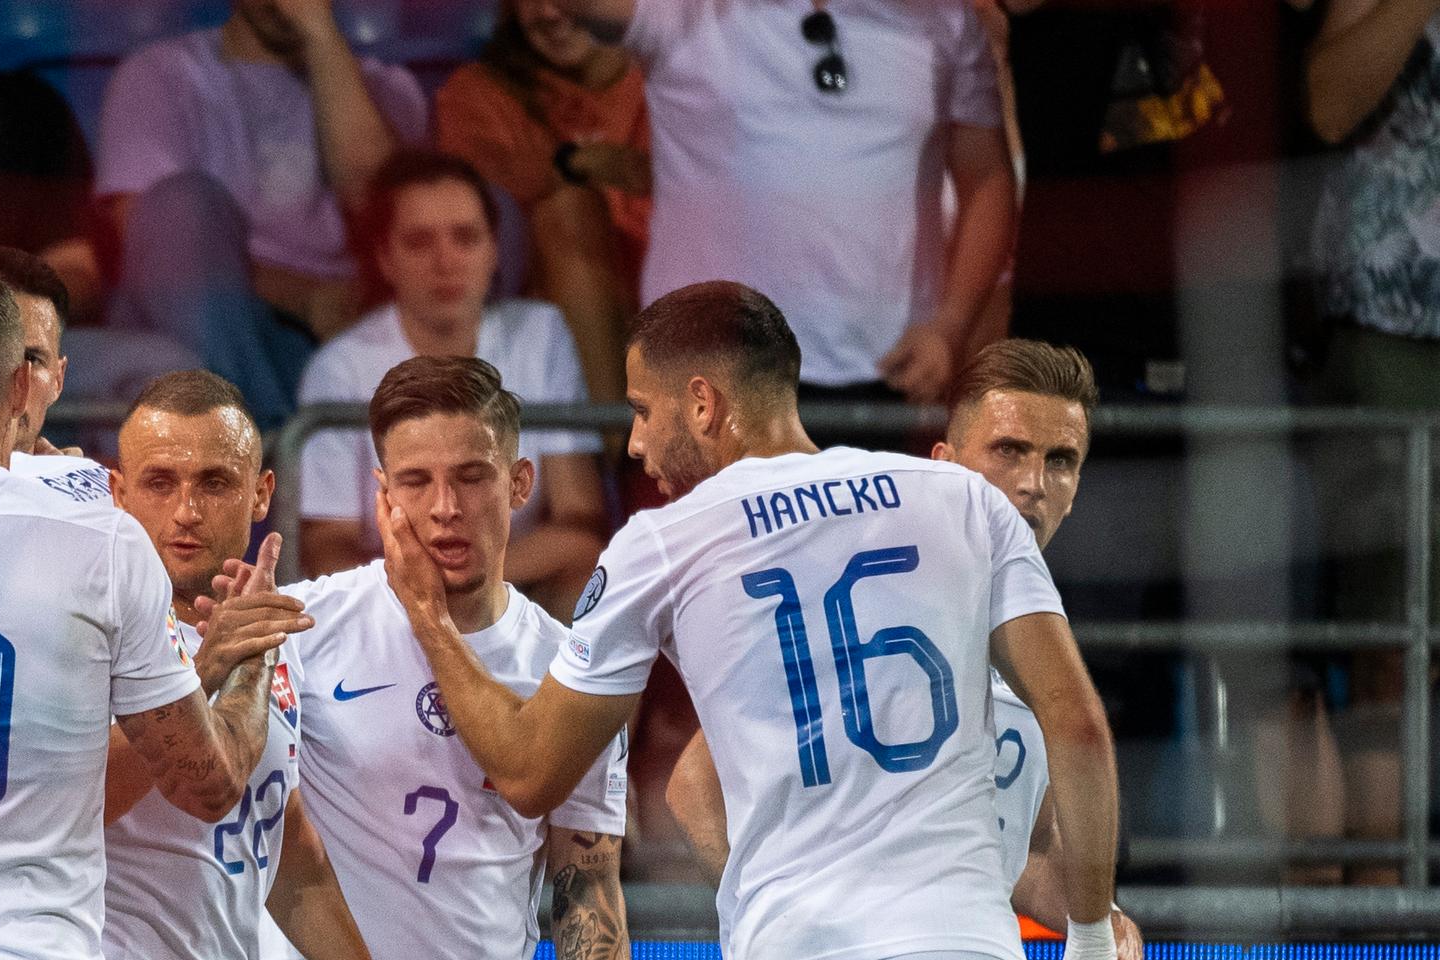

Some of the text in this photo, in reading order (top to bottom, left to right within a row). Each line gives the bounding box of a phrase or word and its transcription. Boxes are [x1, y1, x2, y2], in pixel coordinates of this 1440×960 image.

[740, 474, 901, 539] HANCKO
[741, 545, 960, 789] 16
[214, 769, 287, 876] 22
[403, 784, 460, 884] 7
